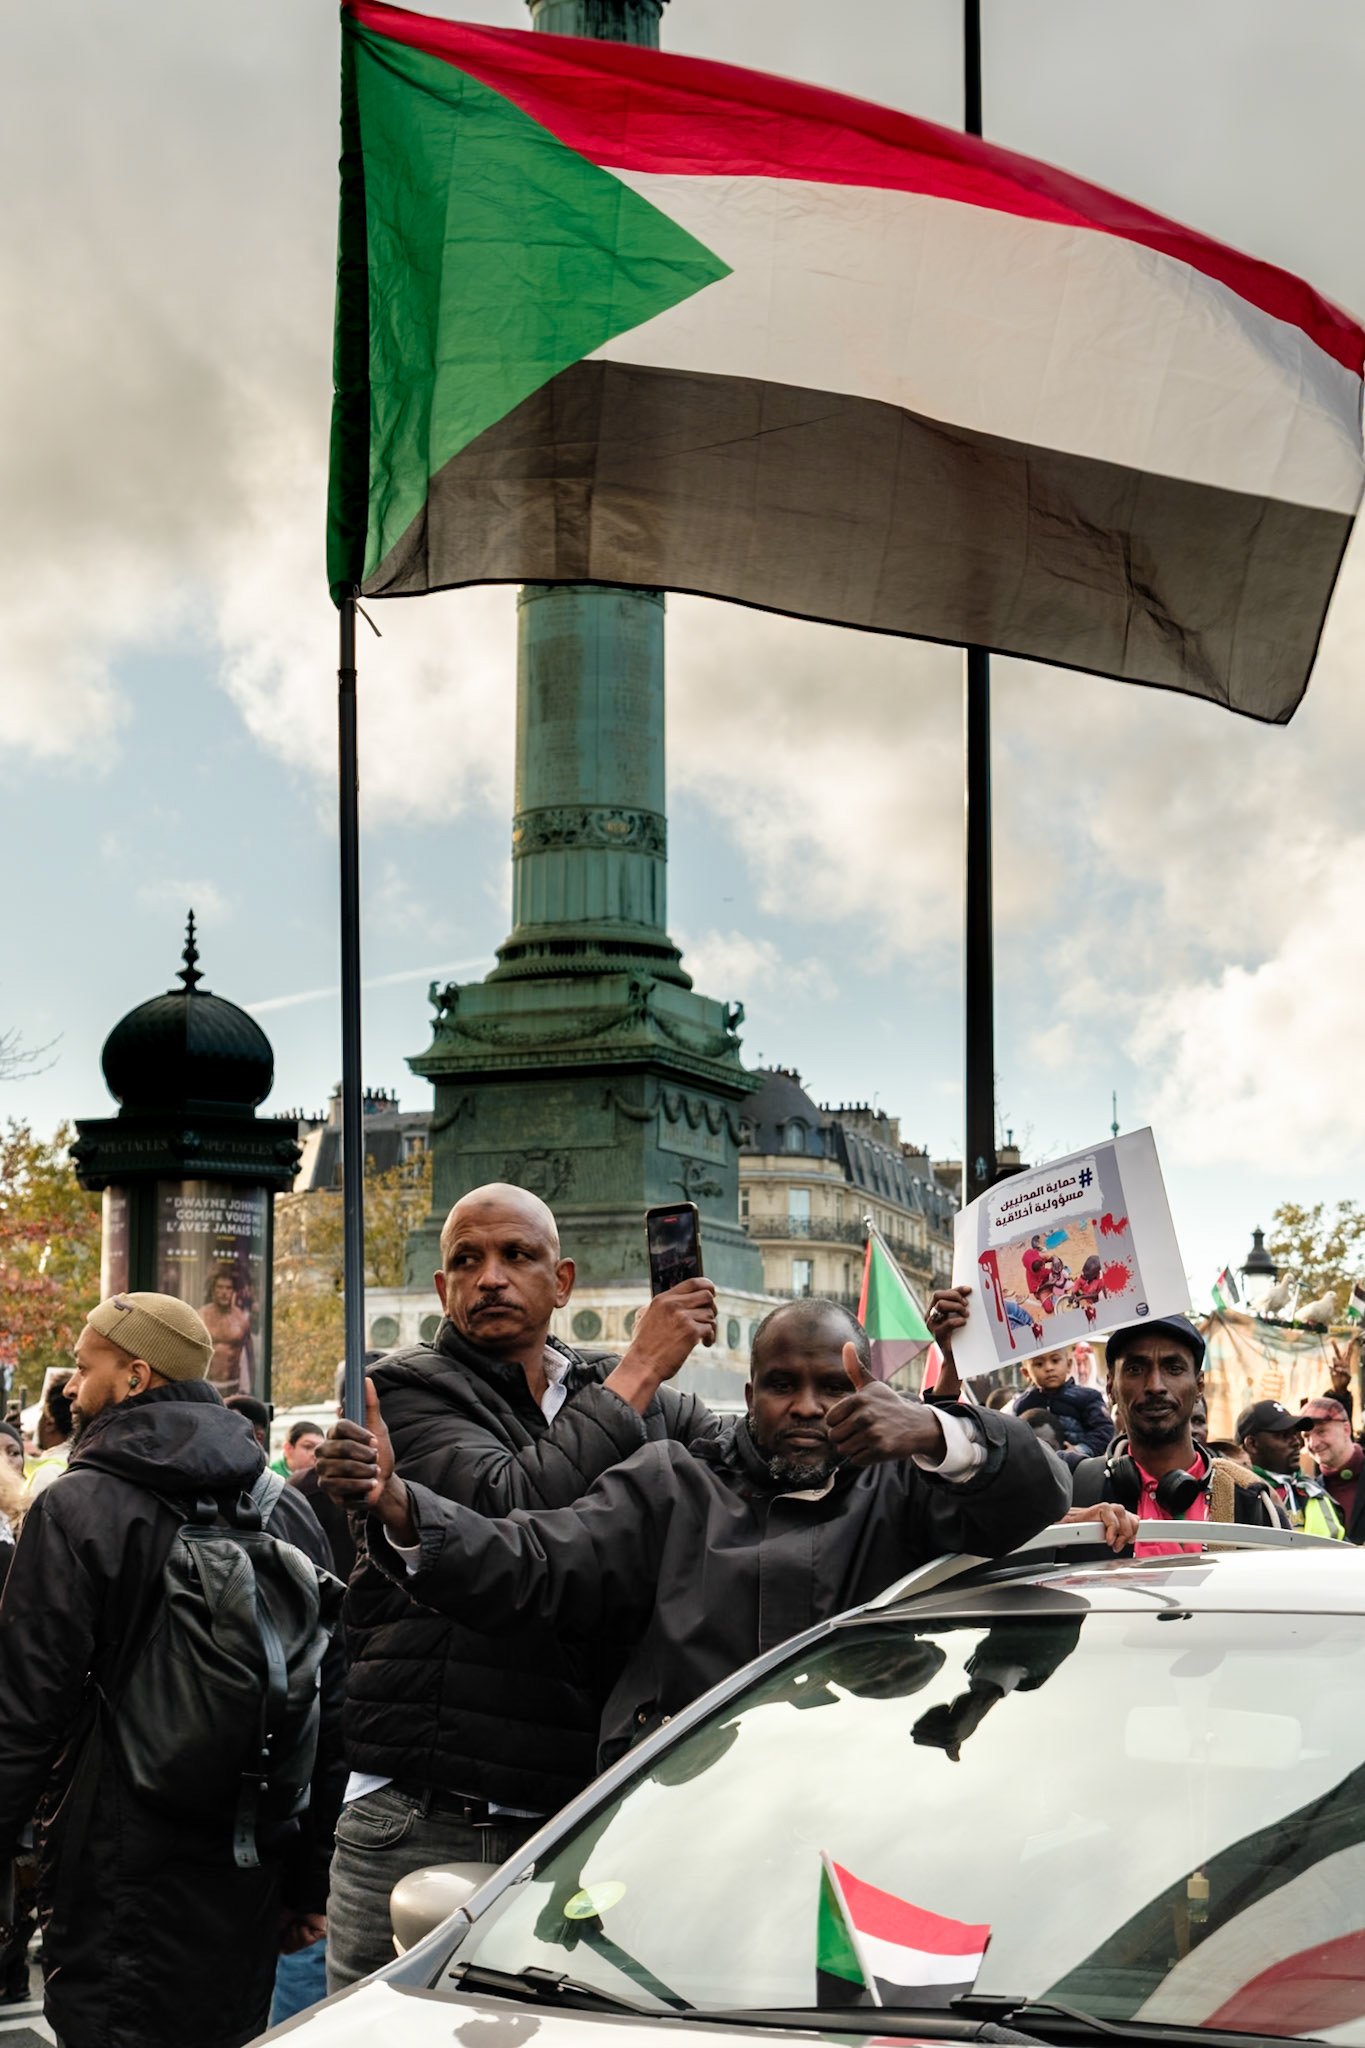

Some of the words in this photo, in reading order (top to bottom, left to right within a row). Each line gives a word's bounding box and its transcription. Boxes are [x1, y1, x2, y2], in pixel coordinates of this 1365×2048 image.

[1000, 1186, 1044, 1212] المدنيين
[1035, 1190, 1084, 1213] مسؤولية
[176, 1209, 222, 1221] COMME
[225, 1211, 251, 1223] VOUS
[995, 1203, 1032, 1227] أخلاقية
[166, 1221, 210, 1233] L'AVEZ
[212, 1223, 251, 1237] JAMAIS
